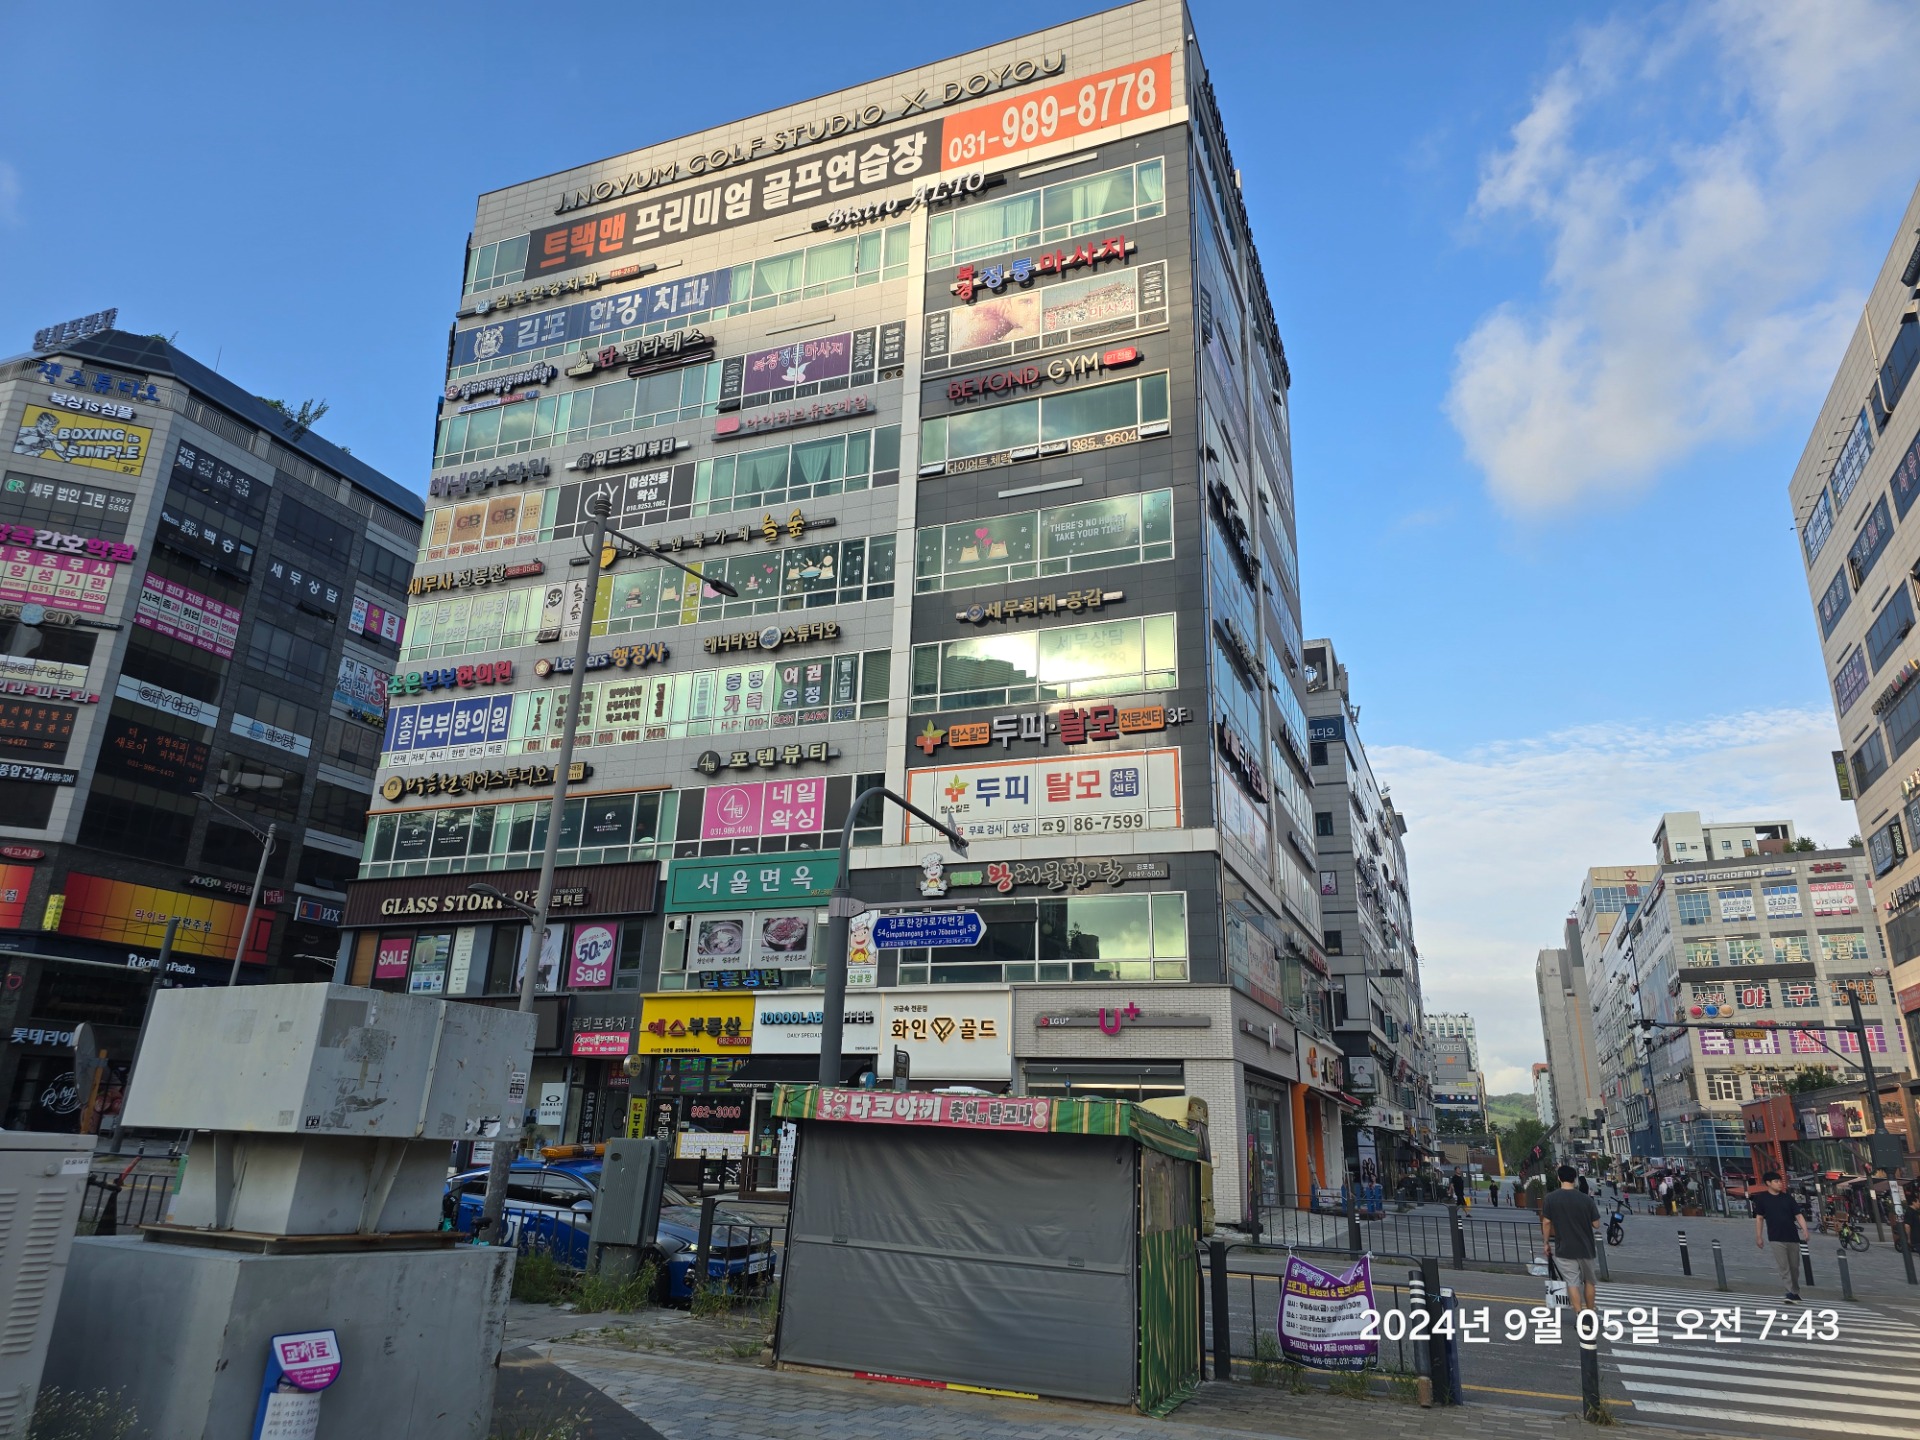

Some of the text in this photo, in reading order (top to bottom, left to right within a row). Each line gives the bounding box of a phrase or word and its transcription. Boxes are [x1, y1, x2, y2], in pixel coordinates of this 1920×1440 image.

[687, 138, 762, 175] GOLF
[773, 104, 884, 152] STUDIO
[943, 49, 1064, 103] DOYOU
[540, 67, 1157, 269] 트랙맨 프리미엄 골프연습장 031-989-8778
[826, 171, 986, 229] Bistro ALTO
[495, 271, 599, 309] 김포한강치과
[517, 277, 709, 348] 김포 한강 치과
[623, 328, 706, 361] 필라테스
[949, 365, 1039, 399] BEYOND
[1047, 352, 1099, 379] GYM
[50, 391, 135, 420] 복싱 is 심플
[57, 428, 141, 443] BOXING is
[66, 445, 140, 460] SIMPLE
[122, 465, 136, 474] 9F
[628, 470, 669, 489] 여성전용
[81, 491, 107, 508] 그린
[636, 489, 659, 501] 왁싱
[1050, 518, 1097, 533] THERE'S NO
[1055, 528, 1099, 542] TAKE YOUR
[430, 550, 443, 560] 031
[486, 540, 498, 550] 031
[503, 536, 516, 547] 985
[518, 534, 536, 545] 0594
[407, 571, 453, 596] 세무사
[83, 592, 106, 602] 9950
[985, 588, 1103, 619] 세무회계 공감
[44, 610, 80, 625] CITY
[704, 621, 839, 654] 애니타임 스튜디오
[611, 642, 667, 668] 행정사
[387, 660, 513, 695] 조은부부한의원
[725, 664, 822, 691] 증명 여권
[172, 693, 199, 717] Cafe
[723, 686, 821, 713] 가족 우정
[834, 708, 853, 720] 4F
[1119, 708, 1163, 729] 전문센터
[1167, 707, 1188, 723] 3F
[397, 705, 509, 746] 조은 부부한의원
[729, 742, 828, 769] 포텐뷰티
[772, 781, 816, 805] 네일
[976, 770, 1137, 807] 두피 탈모 전문
[1112, 783, 1137, 796] 센터
[770, 809, 815, 830] 왁싱
[968, 823, 1029, 836] 무료 검사 상담
[189, 875, 222, 888] 7080
[697, 866, 814, 895] 서울면옥
[1708, 869, 1760, 880] ACADEMY
[381, 896, 438, 915] GLASS
[135, 909, 167, 924] 라이브
[877, 928, 886, 937] 54
[925, 928, 937, 936] 9-ro
[967, 924, 977, 932] 58
[171, 960, 196, 974] Pasta
[379, 950, 409, 966] SALE
[575, 966, 606, 984] Sale
[647, 1015, 742, 1038] 예스부동산
[760, 1010, 823, 1025] 10000LAB
[1099, 1001, 1141, 1035] U+
[890, 1018, 997, 1040] 화인 골드
[717, 1037, 749, 1046] 982-3000
[1436, 1043, 1465, 1052] HOTEL
[690, 1105, 741, 1119] 982-3000
[850, 1095, 942, 1122] 다코야끼
[949, 1100, 987, 1125] 추억의
[988, 1102, 1034, 1127] 달고나
[1286, 1280, 1308, 1295] 프로그램
[284, 1341, 330, 1362] 교차로
